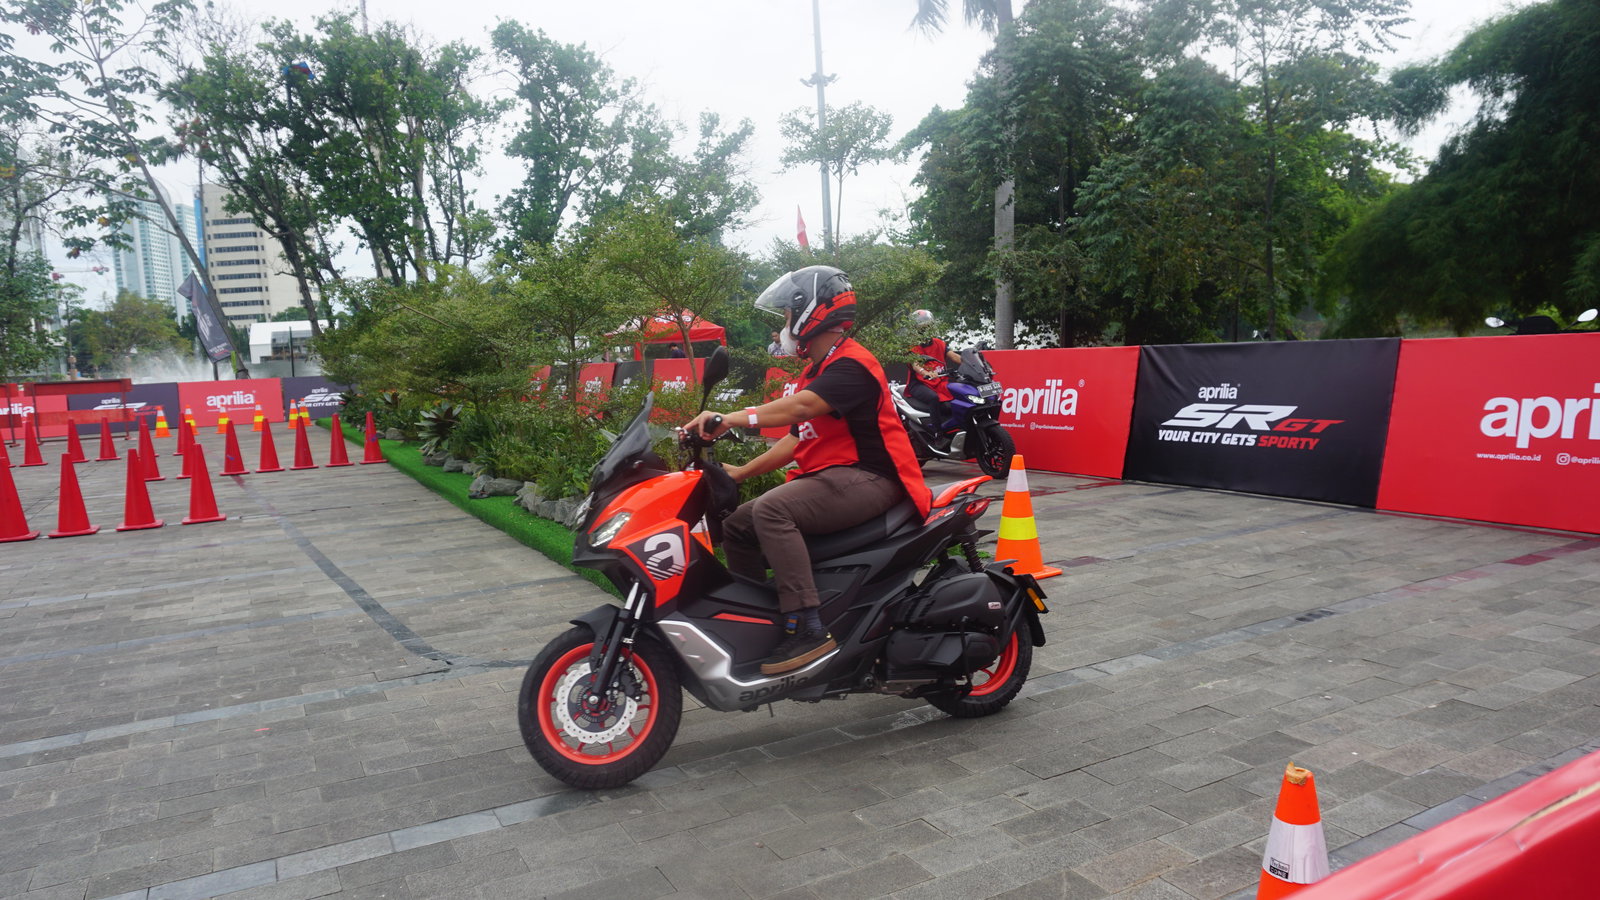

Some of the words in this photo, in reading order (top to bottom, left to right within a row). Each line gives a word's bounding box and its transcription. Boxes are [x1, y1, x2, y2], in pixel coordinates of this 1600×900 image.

[206, 390, 255, 408] aprilia
[1002, 379, 1079, 420] aprilia
[1199, 383, 1239, 401] aprilia
[1161, 403, 1298, 431] SR
[1272, 418, 1346, 433] GT
[1158, 429, 1190, 443] YOUR
[1191, 431, 1221, 444] CITY
[1221, 433, 1257, 447] GETS
[1257, 435, 1320, 450] SPORTY
[1476, 453, 1541, 462] www.aprilia.co.id
[739, 675, 809, 701] aprilia
